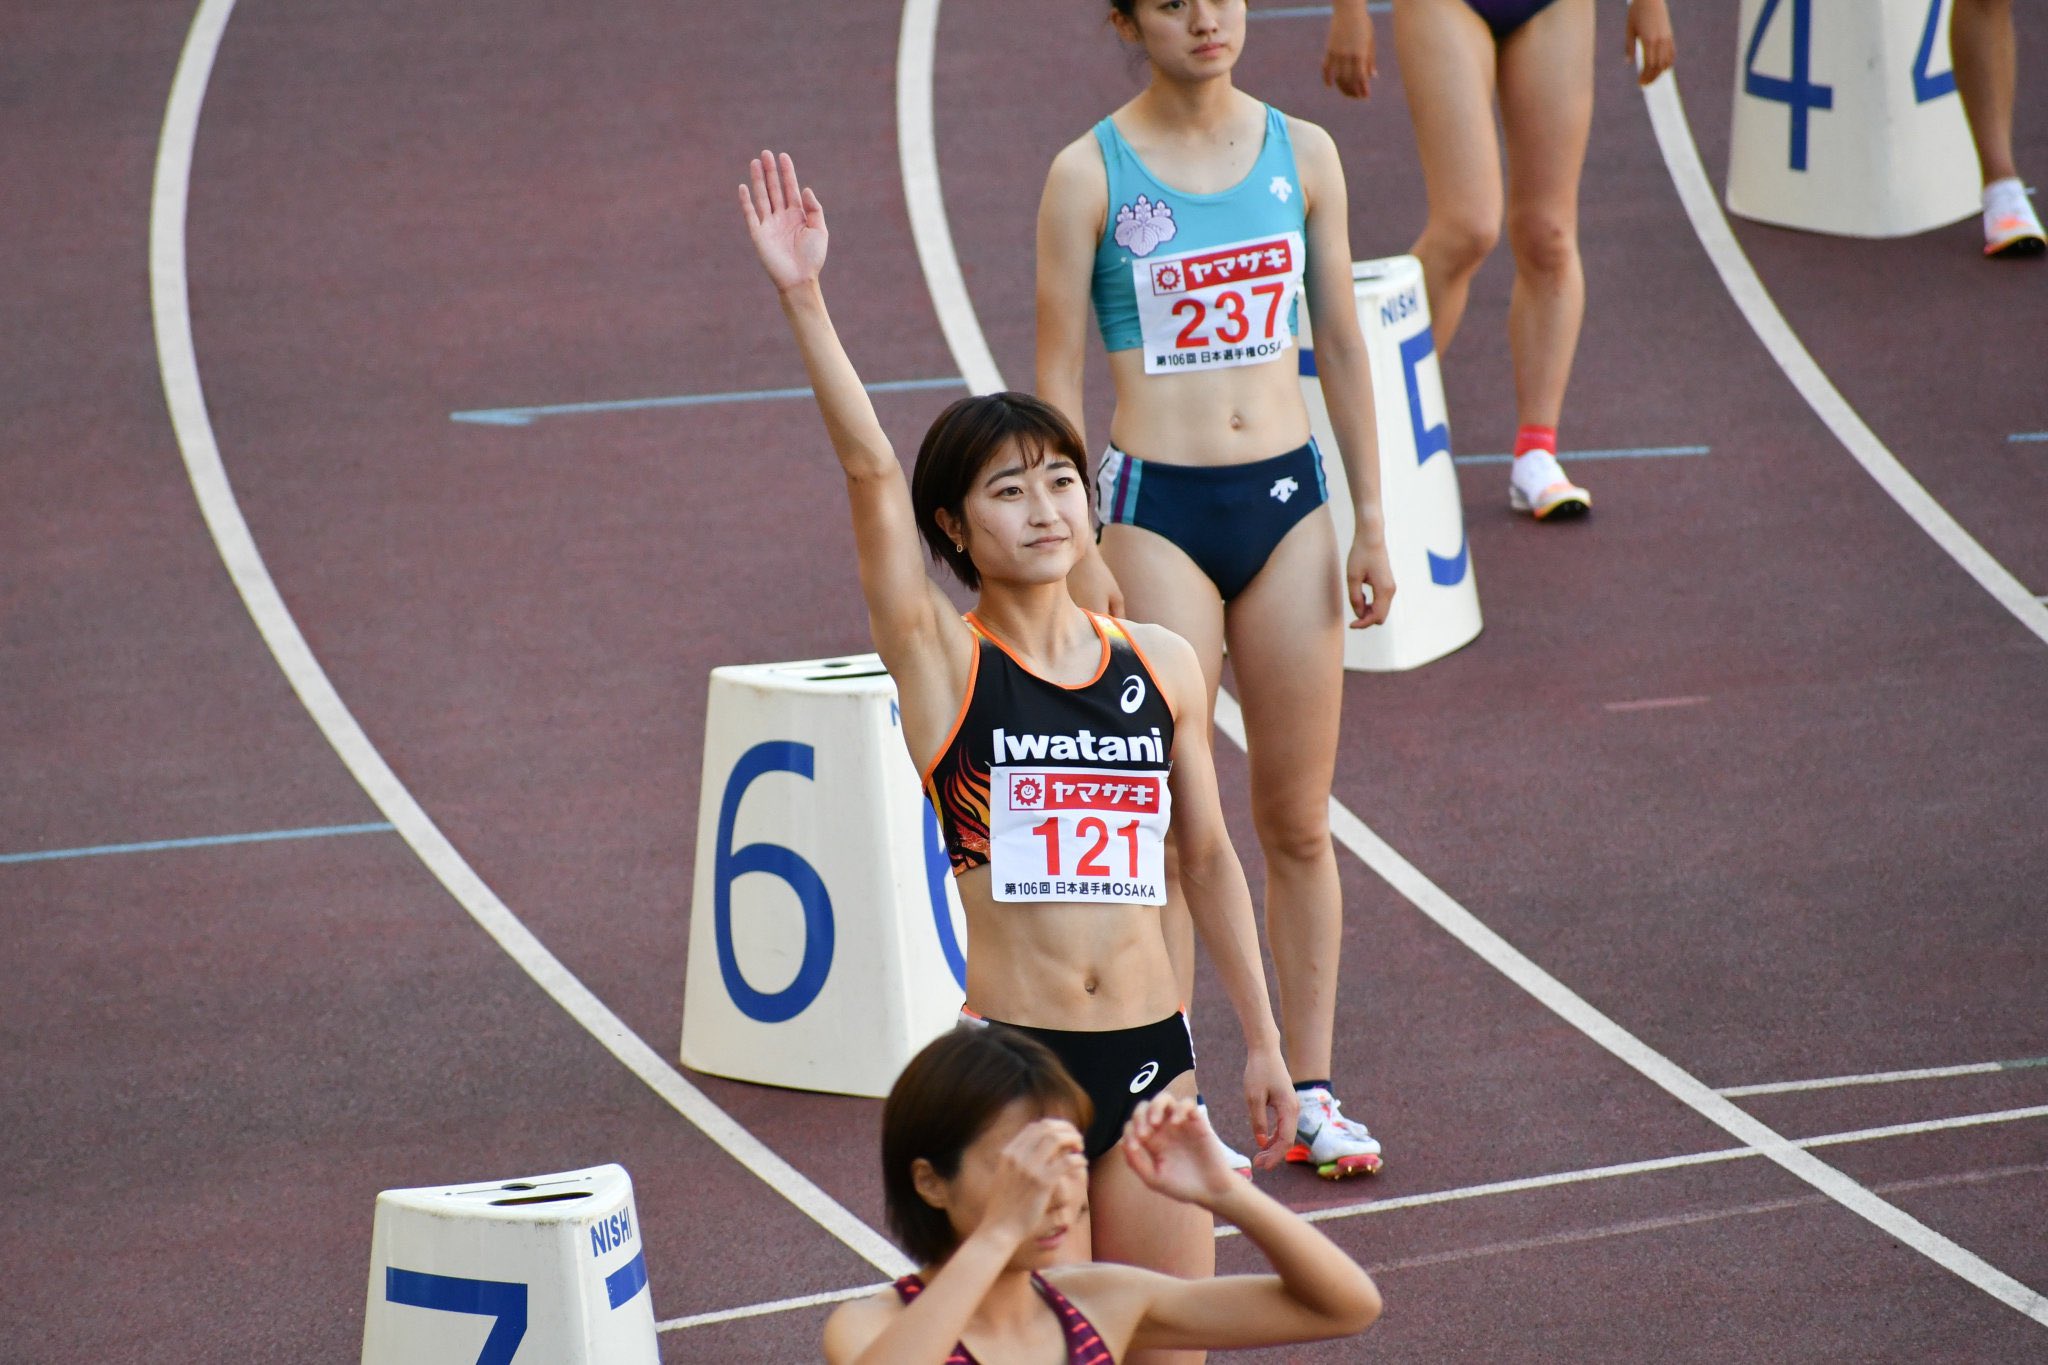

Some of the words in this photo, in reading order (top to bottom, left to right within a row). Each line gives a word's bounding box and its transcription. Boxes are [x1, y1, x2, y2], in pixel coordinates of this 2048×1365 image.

[1745, 0, 1833, 171] 4
[1189, 247, 1288, 284] ヤマザキ
[1171, 281, 1286, 350] 237
[1156, 352, 1197, 367] 第106回
[1397, 325, 1468, 587] 5
[992, 727, 1164, 764] Iwatani
[1052, 781, 1154, 806] ヤマザキ
[1032, 816, 1141, 878] 121
[714, 739, 835, 1024] 6
[1005, 881, 1051, 896] 第106回
[1056, 881, 1156, 899] 日本選手権OSAKA
[589, 1206, 633, 1258] NISHI
